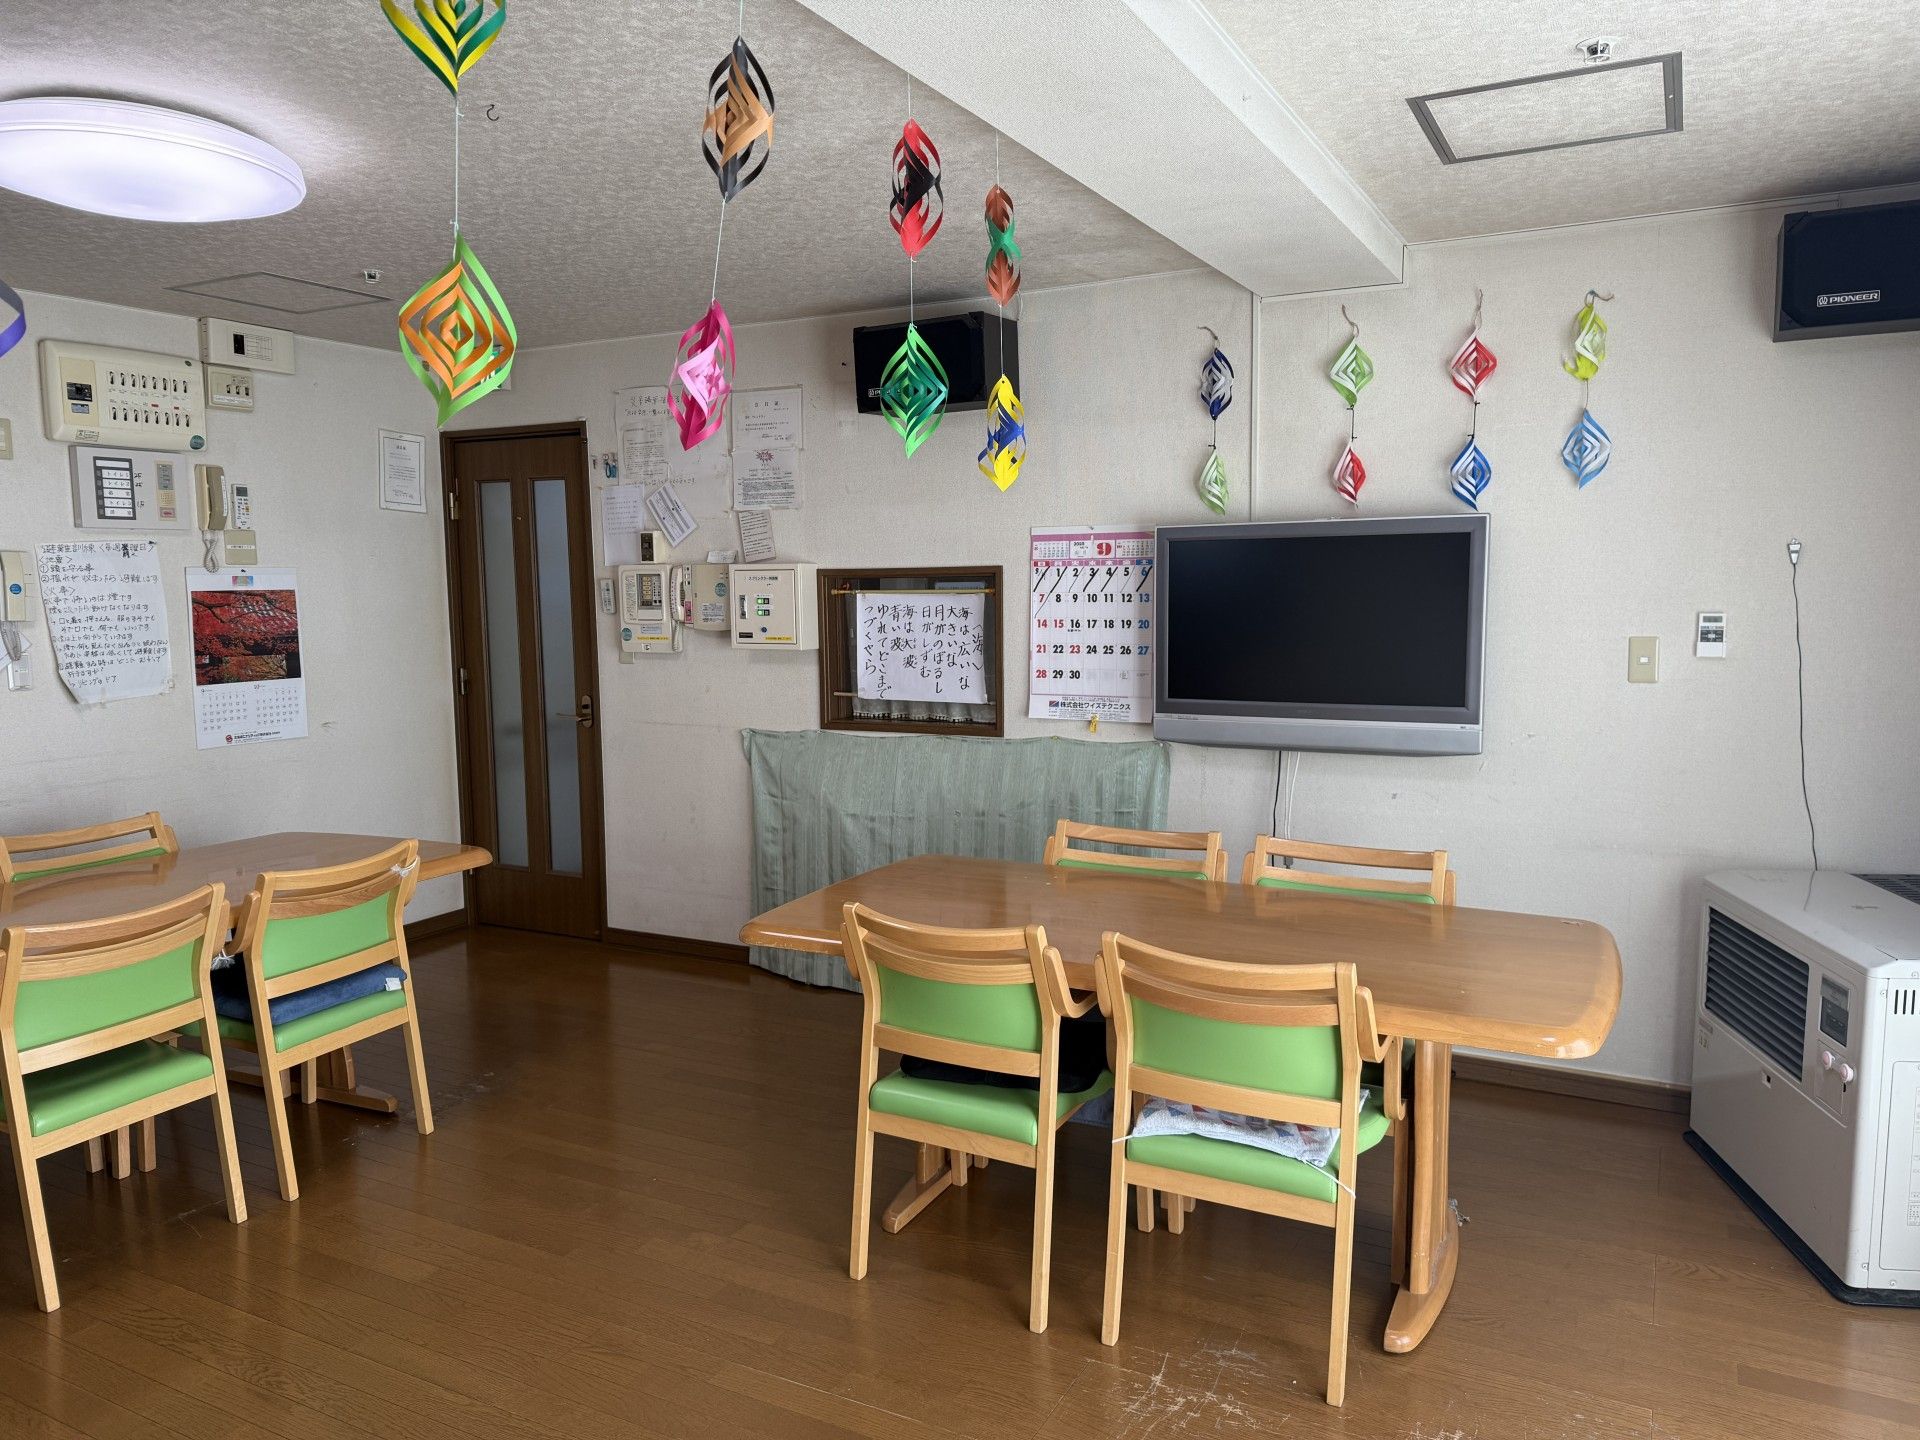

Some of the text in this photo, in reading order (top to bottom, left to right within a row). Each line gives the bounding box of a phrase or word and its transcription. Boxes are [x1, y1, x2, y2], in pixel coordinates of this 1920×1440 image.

[1829, 293, 1878, 304] PIONEER
[1097, 542, 1112, 556] 9
[1057, 568, 1060, 577] 1
[1073, 568, 1078, 576] 2
[1090, 568, 1095, 576] 3
[1106, 568, 1112, 576] 4
[1124, 567, 1129, 576] 5
[1141, 568, 1147, 576] 6
[1039, 594, 1149, 602] 7 8 9 10 11 12 13
[890, 604, 903, 651] 青い波
[1037, 619, 1149, 628] 14 15 16 17 18 19 20
[864, 606, 877, 675] つづくやら
[920, 606, 933, 678] 日がしずむ
[946, 606, 958, 668] 大きいな
[876, 604, 892, 699] ゆれてどこまで
[933, 604, 946, 694] 月がのぼるし
[958, 607, 973, 690] 海は広いな
[1036, 645, 1149, 655] 21 22 23 24 25 26 27
[1036, 670, 1080, 679] 28 29 30
[1060, 701, 1131, 710] 株式会社ワイズテクニクス
